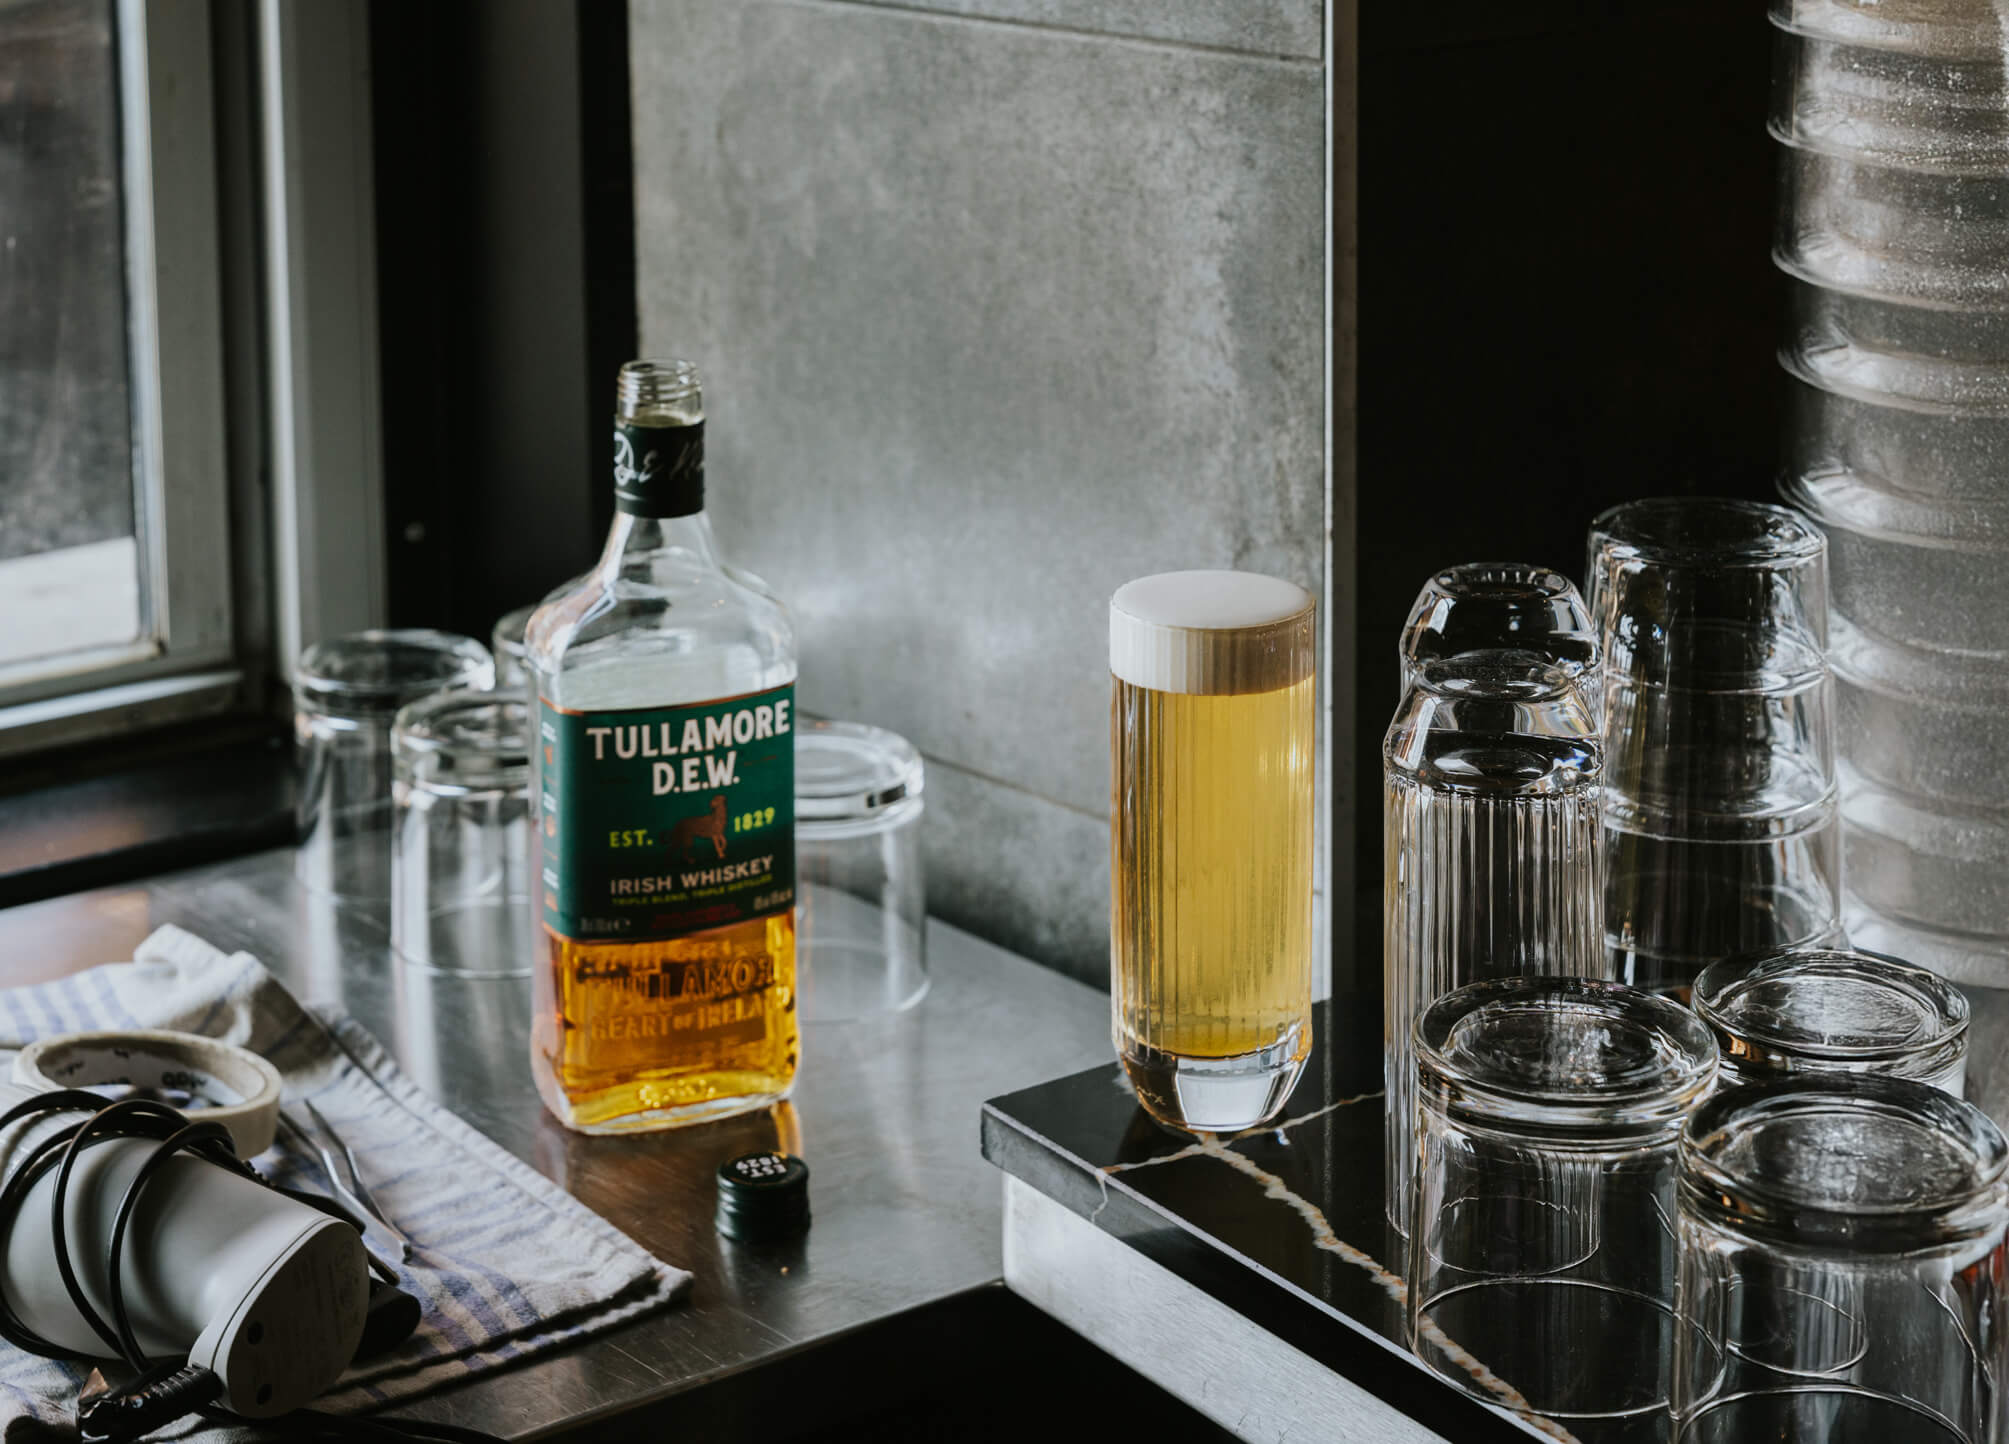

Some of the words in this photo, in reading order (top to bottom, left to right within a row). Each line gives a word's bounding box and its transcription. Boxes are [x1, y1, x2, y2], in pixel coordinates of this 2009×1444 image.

[586, 699, 791, 760] TULLAMORE
[652, 751, 740, 795] D.E.W.
[609, 829, 653, 848] EST.
[734, 807, 775, 832] 1829
[610, 876, 673, 895] IRISH
[680, 854, 774, 888] WHISKEY
